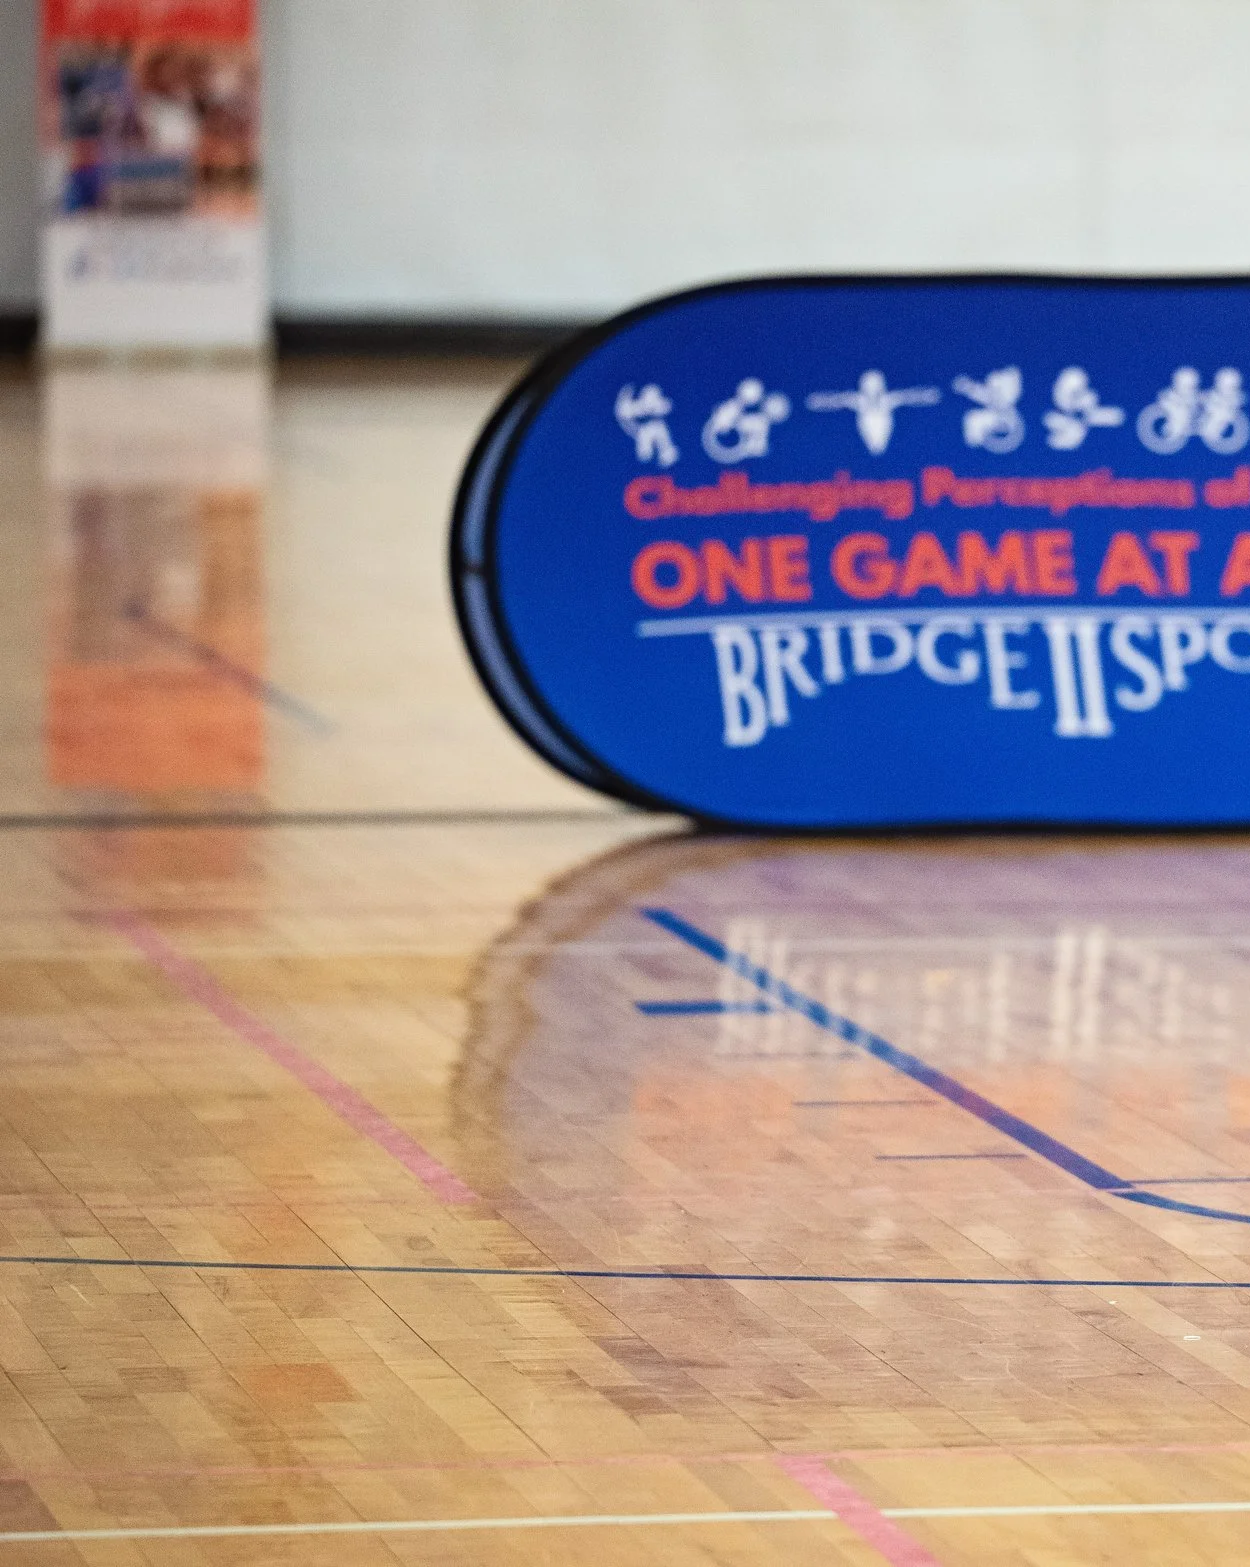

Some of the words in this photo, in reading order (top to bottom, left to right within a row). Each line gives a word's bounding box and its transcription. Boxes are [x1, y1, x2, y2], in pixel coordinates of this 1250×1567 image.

[624, 471, 914, 521] Challenging
[921, 466, 1195, 515] Perceptions
[631, 538, 812, 609] ONE
[830, 529, 1077, 599] GAME
[1097, 531, 1199, 597] AT
